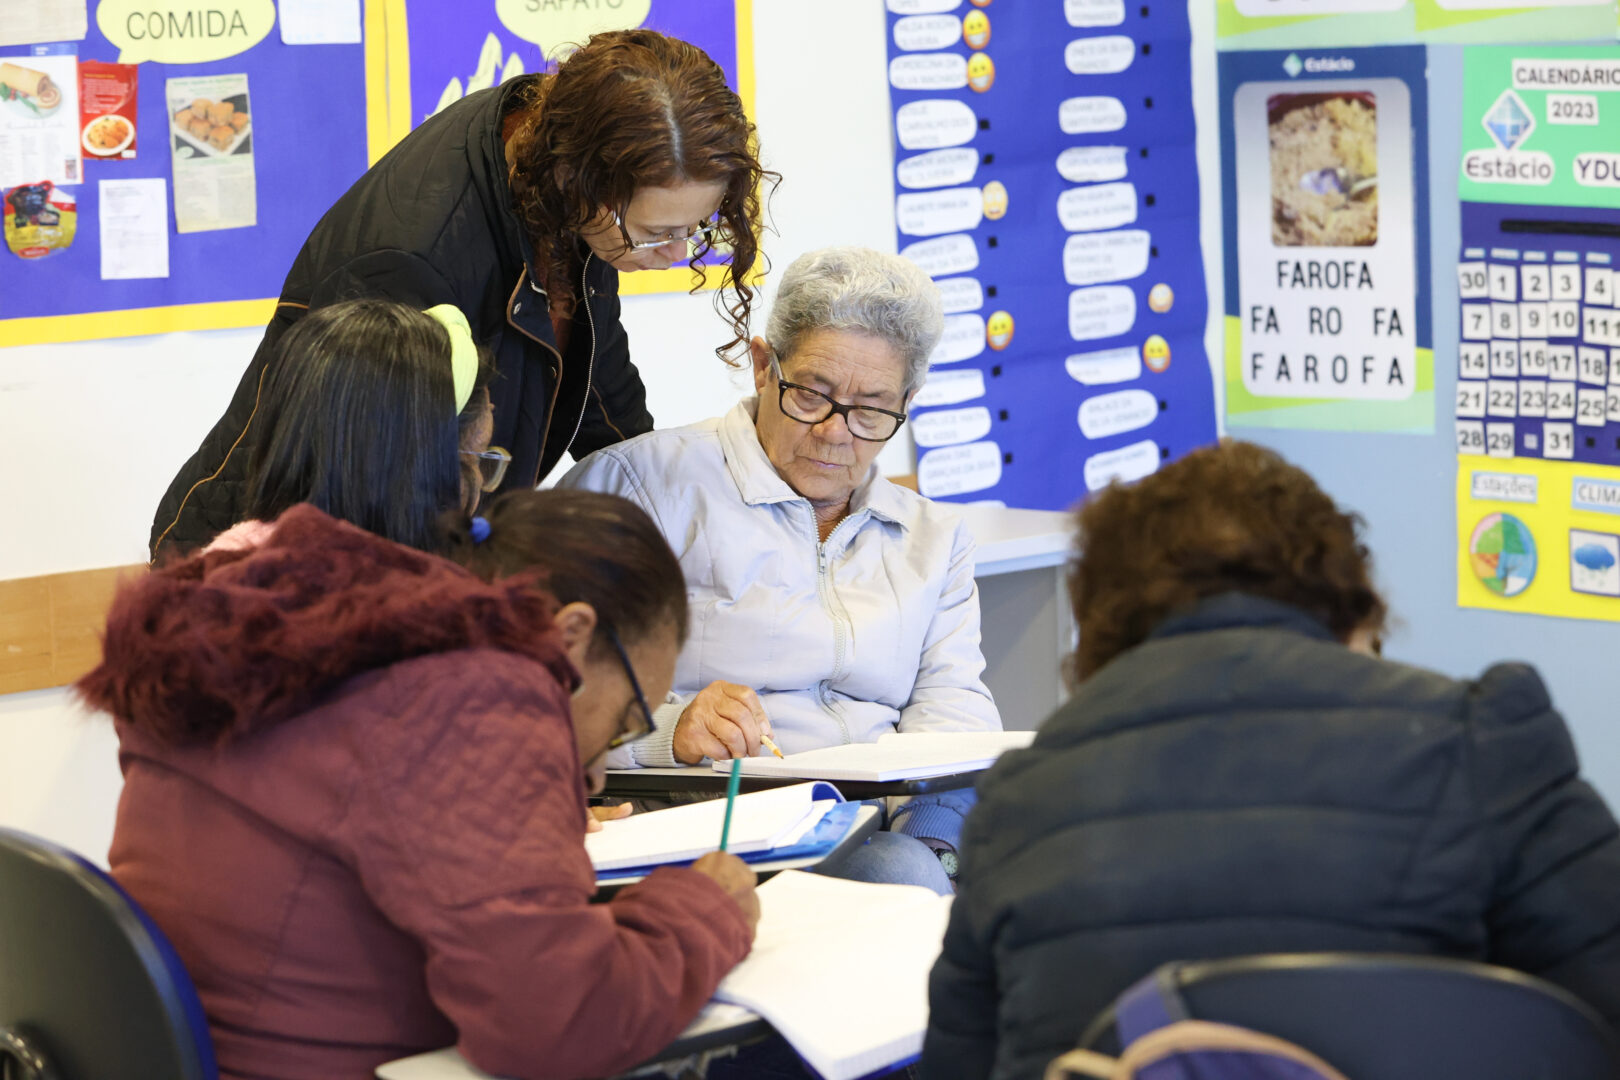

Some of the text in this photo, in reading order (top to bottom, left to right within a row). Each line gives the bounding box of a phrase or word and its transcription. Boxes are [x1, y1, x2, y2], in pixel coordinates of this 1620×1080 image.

[126, 9, 248, 40] COMIDA
[1304, 56, 1355, 73] Estácio
[1553, 101, 1594, 118] 2023
[1466, 155, 1552, 179] Estácio
[1277, 260, 1374, 289] FAROFA
[1461, 272, 1605, 295] 30 1 2 3 4
[1251, 305, 1403, 336] FA RO FA
[1472, 314, 1483, 331] 7
[1500, 313, 1511, 330] 8
[1529, 311, 1540, 328] 9
[1552, 311, 1575, 328] 10
[1587, 318, 1608, 336] 11
[1462, 353, 1485, 369] 14
[1493, 350, 1515, 368] 15
[1523, 350, 1545, 367] 16
[1550, 354, 1572, 371] 17
[1583, 358, 1604, 376] 18
[1459, 391, 1480, 408] 21
[1490, 390, 1515, 407] 22
[1523, 391, 1545, 407] 23
[1551, 392, 1573, 409] 24
[1580, 400, 1603, 417] 25
[1459, 430, 1571, 450] 28 29 31
